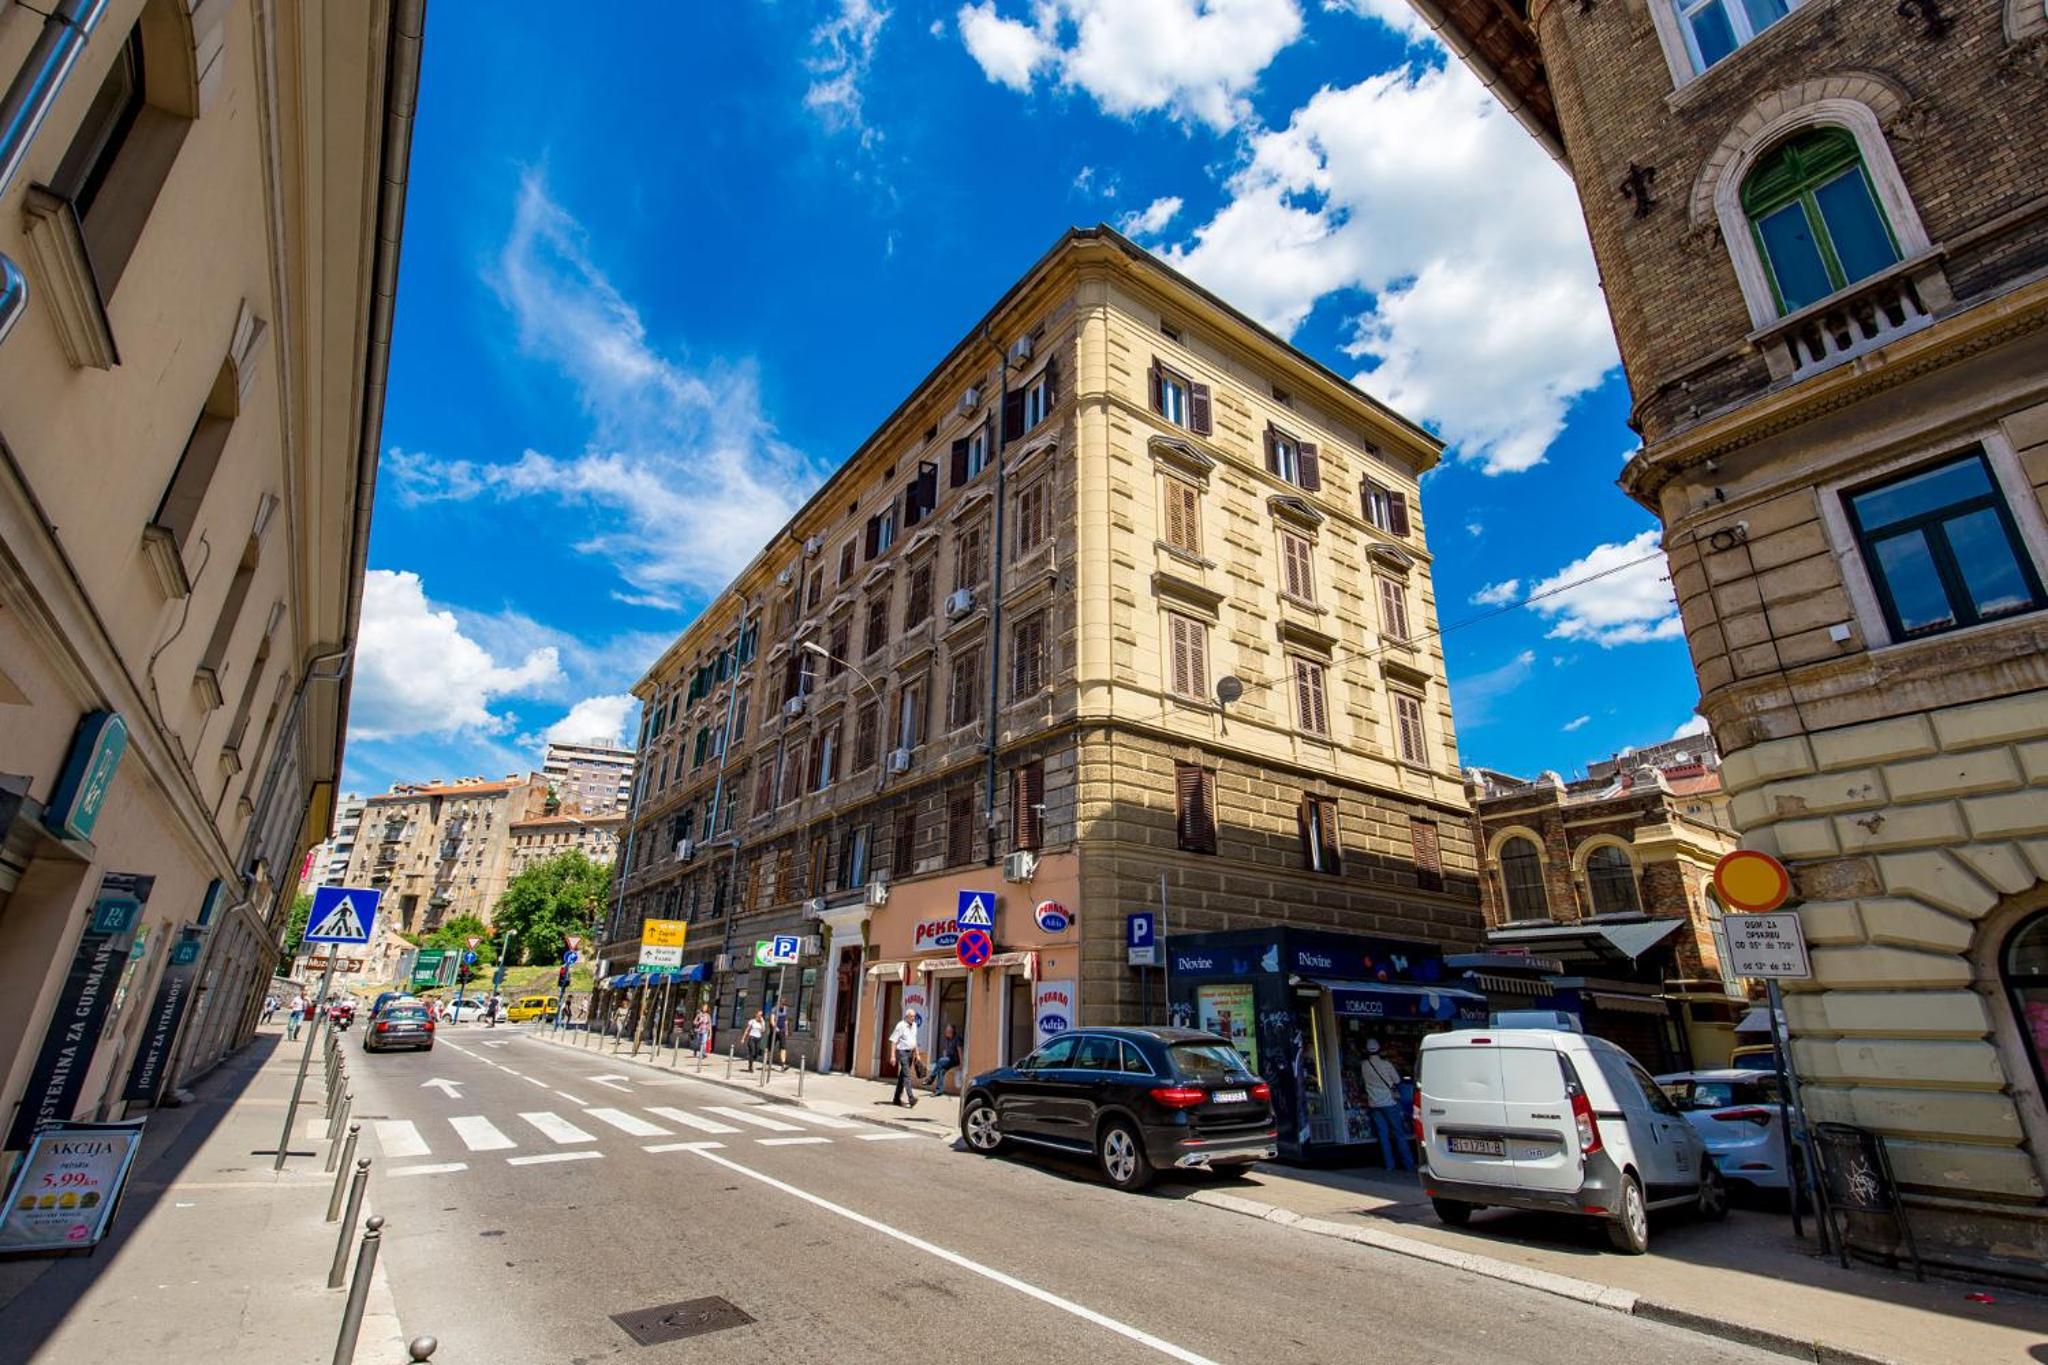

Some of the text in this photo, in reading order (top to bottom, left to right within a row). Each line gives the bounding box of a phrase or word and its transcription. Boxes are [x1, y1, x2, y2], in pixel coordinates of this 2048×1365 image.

[1133, 918, 1148, 944] P
[779, 942, 791, 956] P
[66, 1020, 86, 1041] ZA
[76, 942, 113, 1018] GURMANE
[1039, 991, 1068, 1008] PEKARA
[1345, 1000, 1383, 1013] TOBACCO
[1041, 1017, 1066, 1031] Adria
[138, 976, 183, 1089] JOGURT ZA VITALNOST
[48, 1142, 112, 1157] AKCIJA
